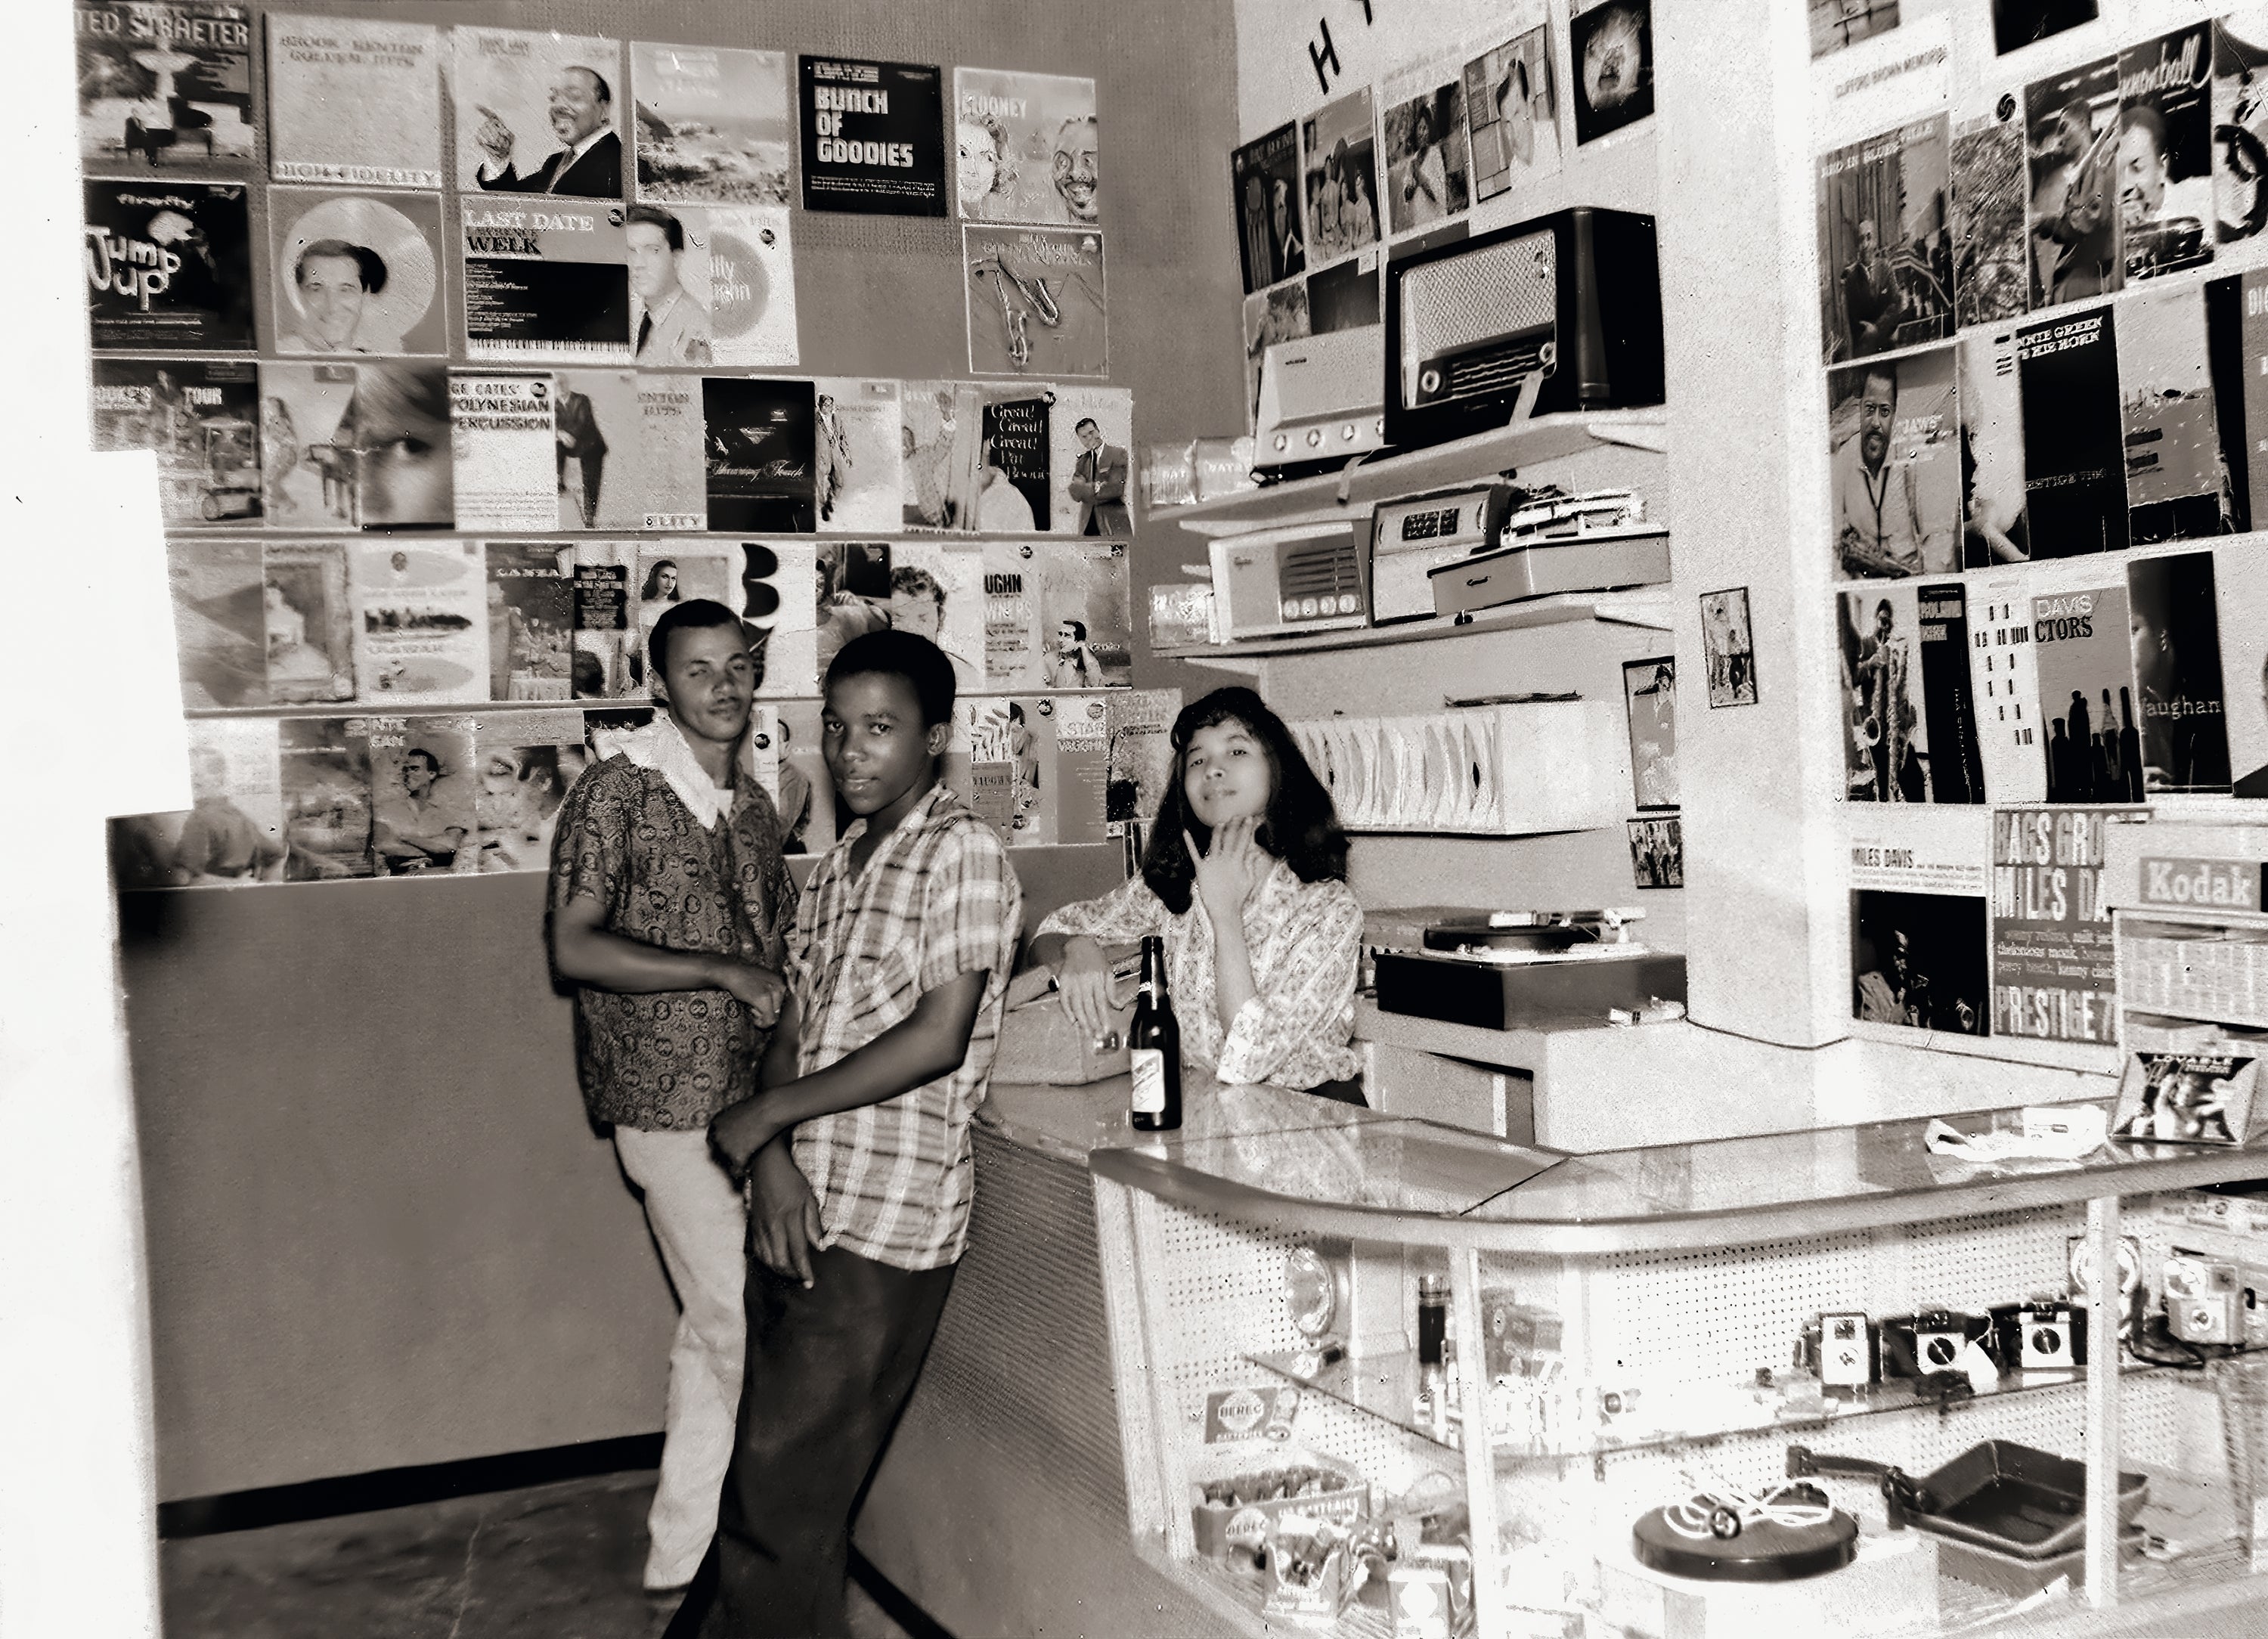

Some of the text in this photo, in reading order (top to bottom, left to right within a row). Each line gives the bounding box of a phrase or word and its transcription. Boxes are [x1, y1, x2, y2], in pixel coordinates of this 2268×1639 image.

[814, 85, 888, 114] BUNCH
[816, 110, 843, 138] OF
[816, 136, 914, 168] GOODIES
[463, 209, 595, 233] LAST DATE
[84, 224, 181, 291] Jump
[113, 265, 170, 311] up
[2053, 315, 2103, 338] GREEN
[984, 573, 1022, 594] UGHN
[2034, 615, 2093, 643] CTORS
[1994, 811, 2052, 867] BAGS
[1994, 866, 2068, 922] MILES
[2147, 860, 2253, 906] Kodak
[1994, 985, 2096, 1040] PRESTIGE
